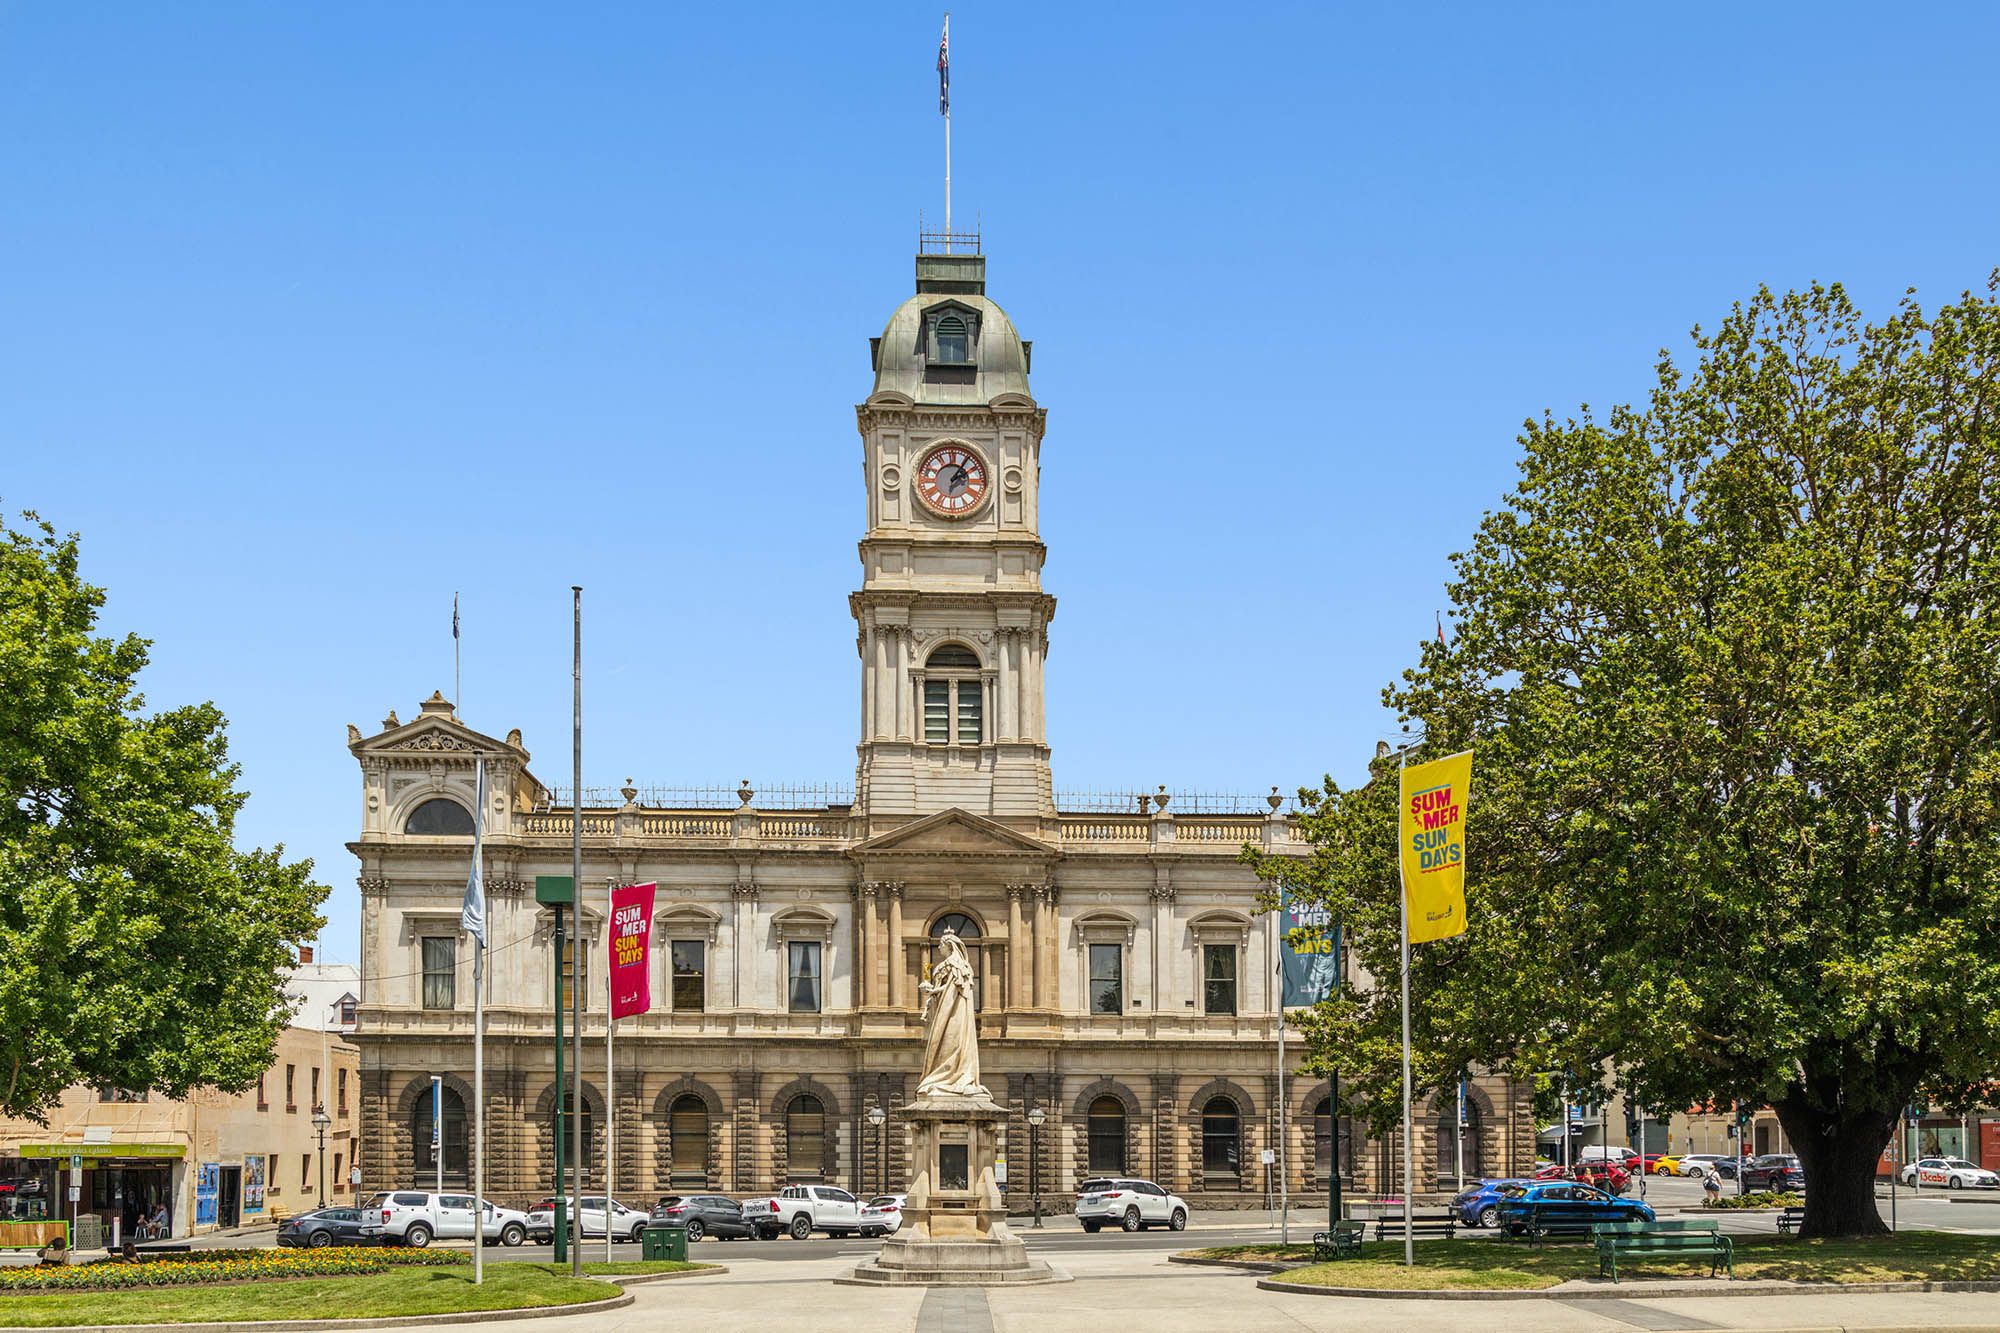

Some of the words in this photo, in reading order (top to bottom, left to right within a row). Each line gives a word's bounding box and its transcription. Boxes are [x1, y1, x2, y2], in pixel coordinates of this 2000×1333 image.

[1411, 788, 1451, 815] SUM
[1423, 805, 1459, 831] MER
[1413, 828, 1446, 851] SUN
[1420, 843, 1461, 869] DAYS
[615, 907, 641, 925] SUM
[1298, 912, 1332, 926] MER
[622, 920, 646, 937] MER
[615, 935, 637, 953] SUN
[619, 946, 643, 965] DAYS
[1920, 1171, 1947, 1183] 13cabs
